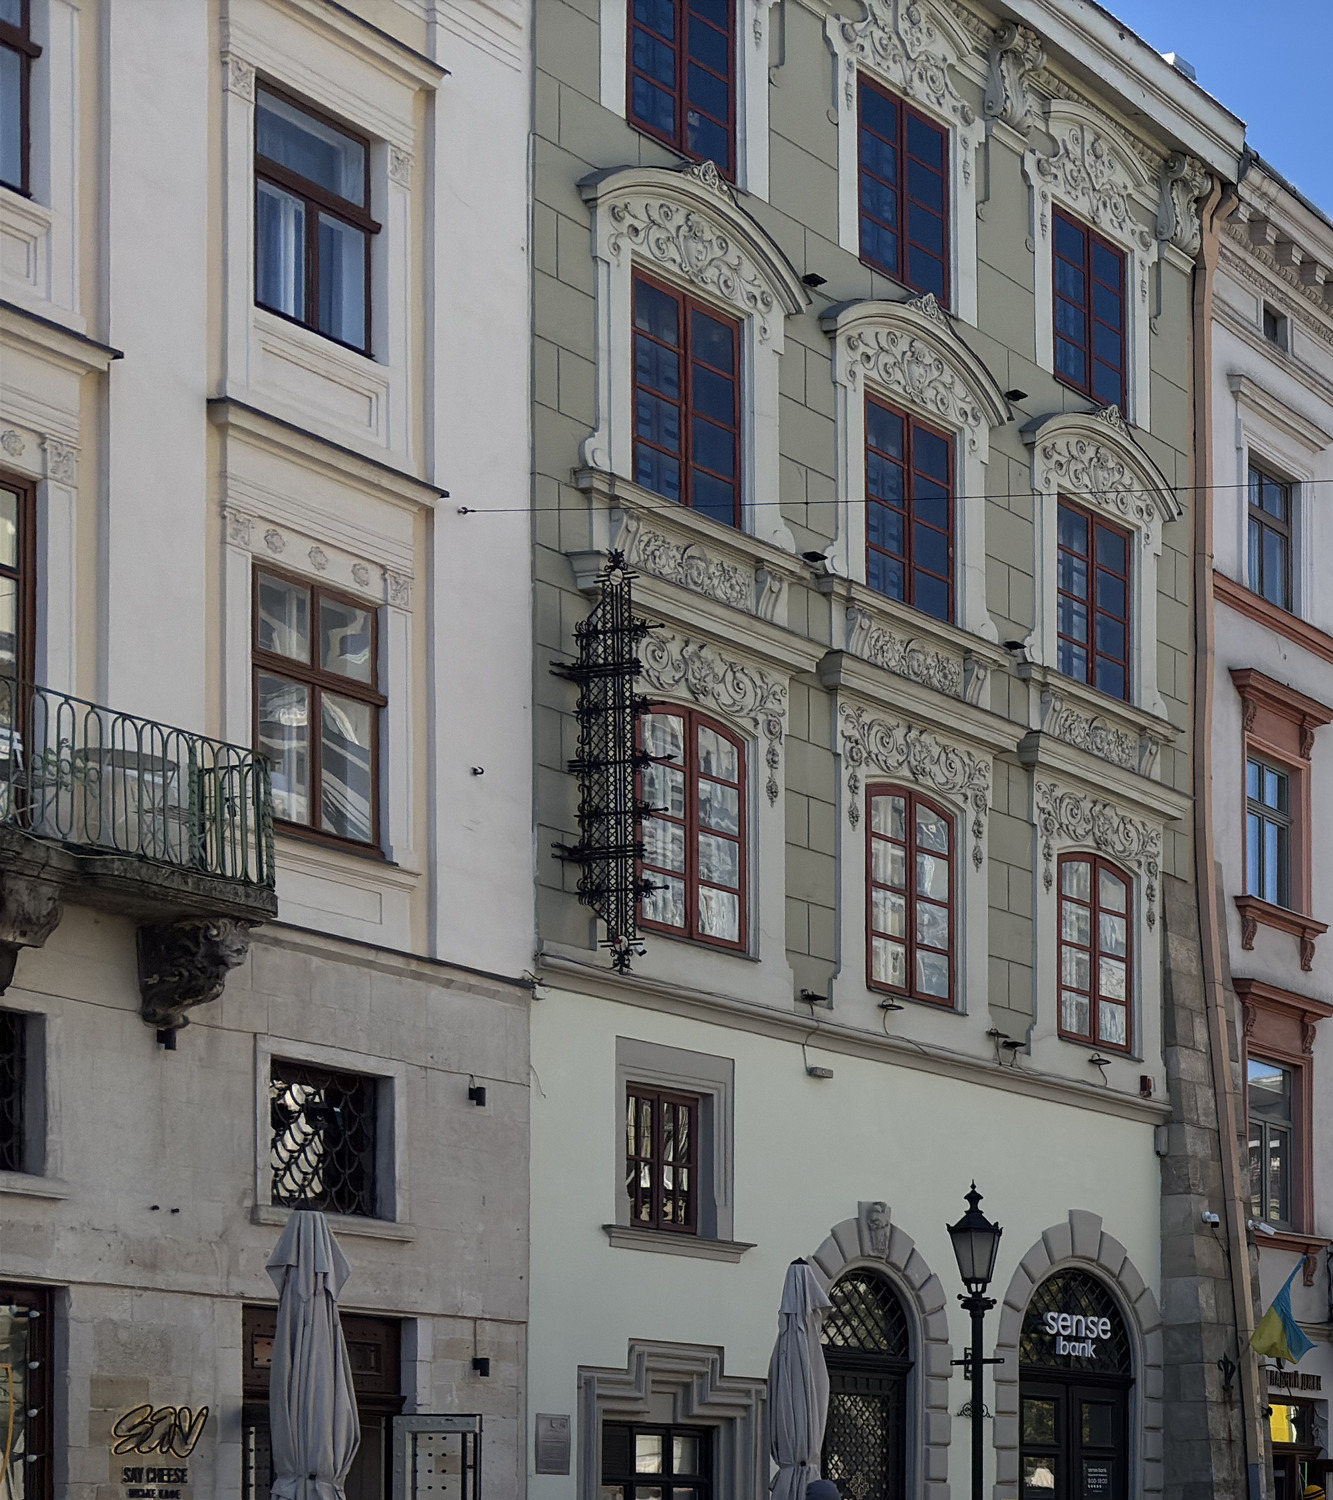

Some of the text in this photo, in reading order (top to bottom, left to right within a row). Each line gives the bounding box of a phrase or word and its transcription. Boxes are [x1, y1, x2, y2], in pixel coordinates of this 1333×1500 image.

[1043, 1311, 1111, 1340] sense
[1056, 1335, 1096, 1358] bank
[123, 1467, 188, 1483] SAY CHEESE
